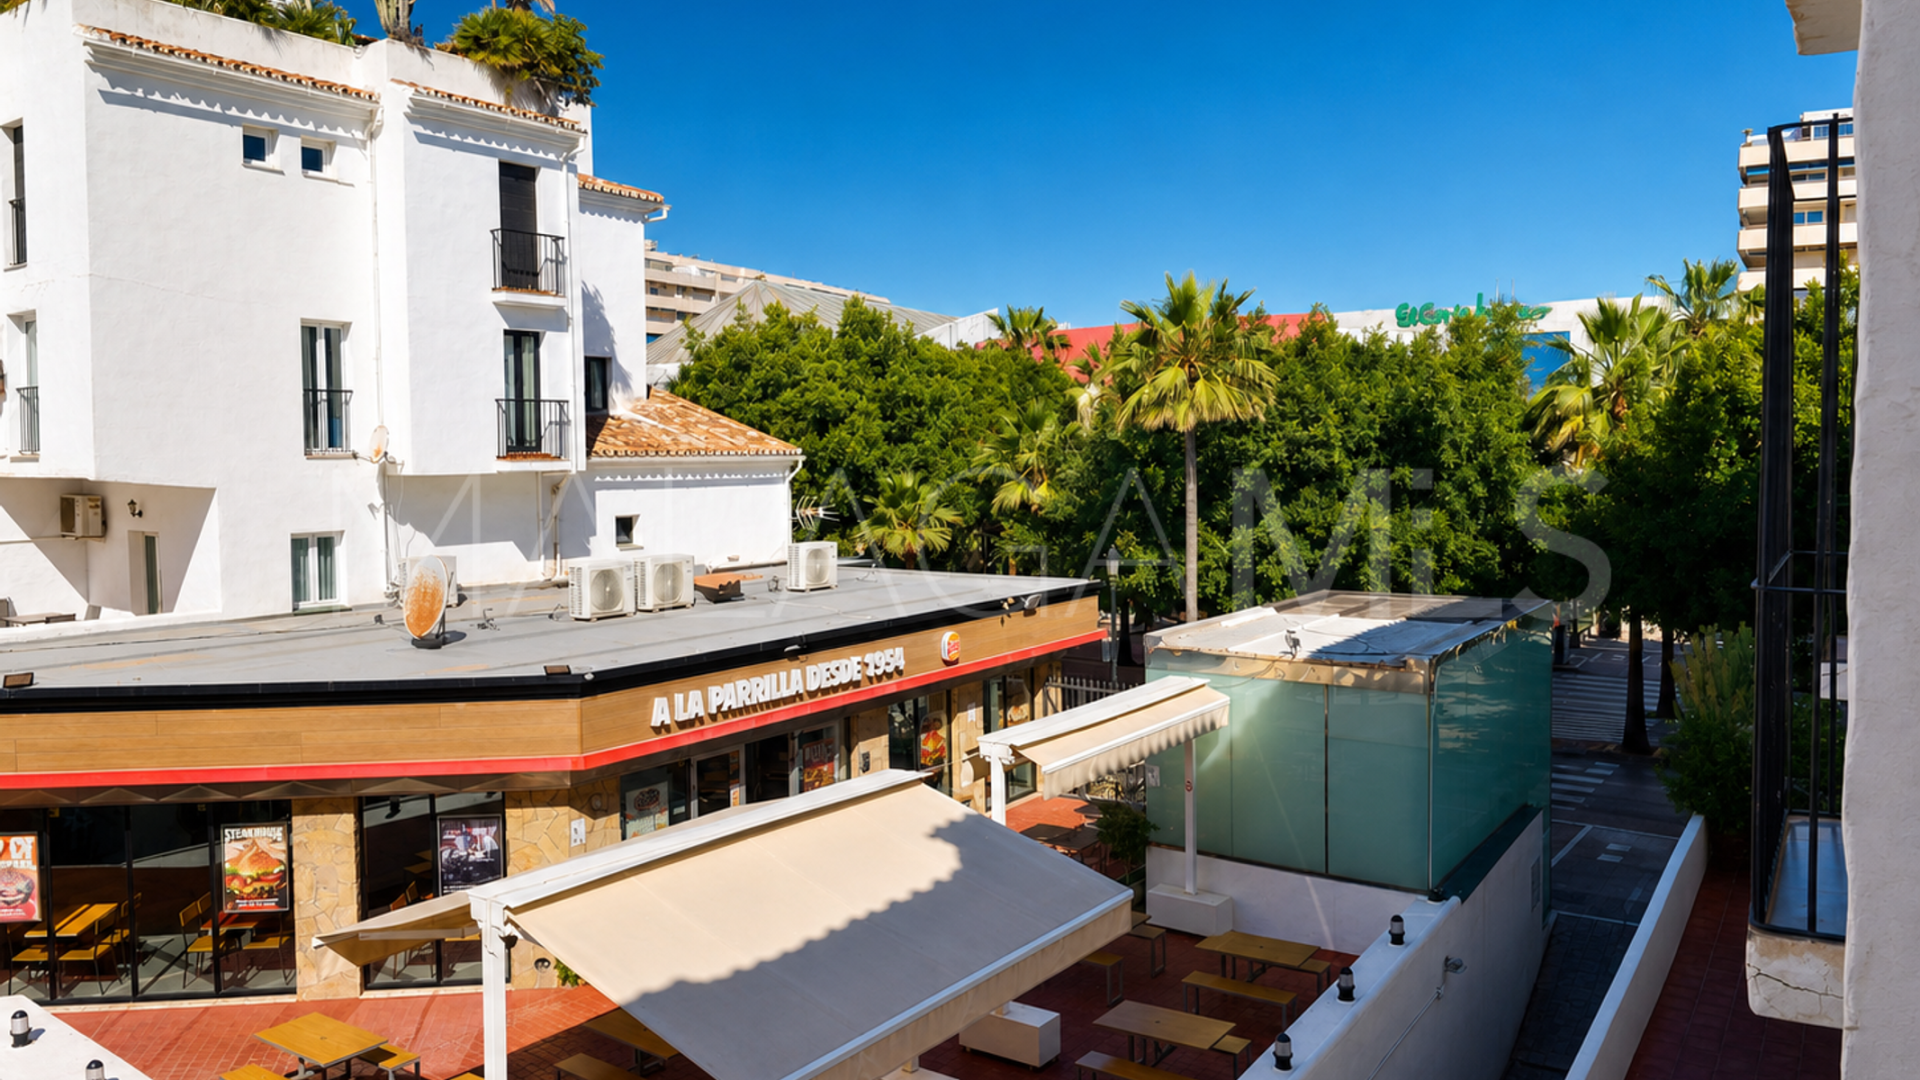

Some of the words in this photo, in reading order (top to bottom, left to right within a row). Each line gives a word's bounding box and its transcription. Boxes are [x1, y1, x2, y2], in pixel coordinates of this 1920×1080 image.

[650, 696, 672, 728] A
[674, 689, 705, 723] LA
[707, 668, 804, 715] PARRILLA
[805, 656, 863, 692] DESDE
[863, 646, 906, 677] 1954
